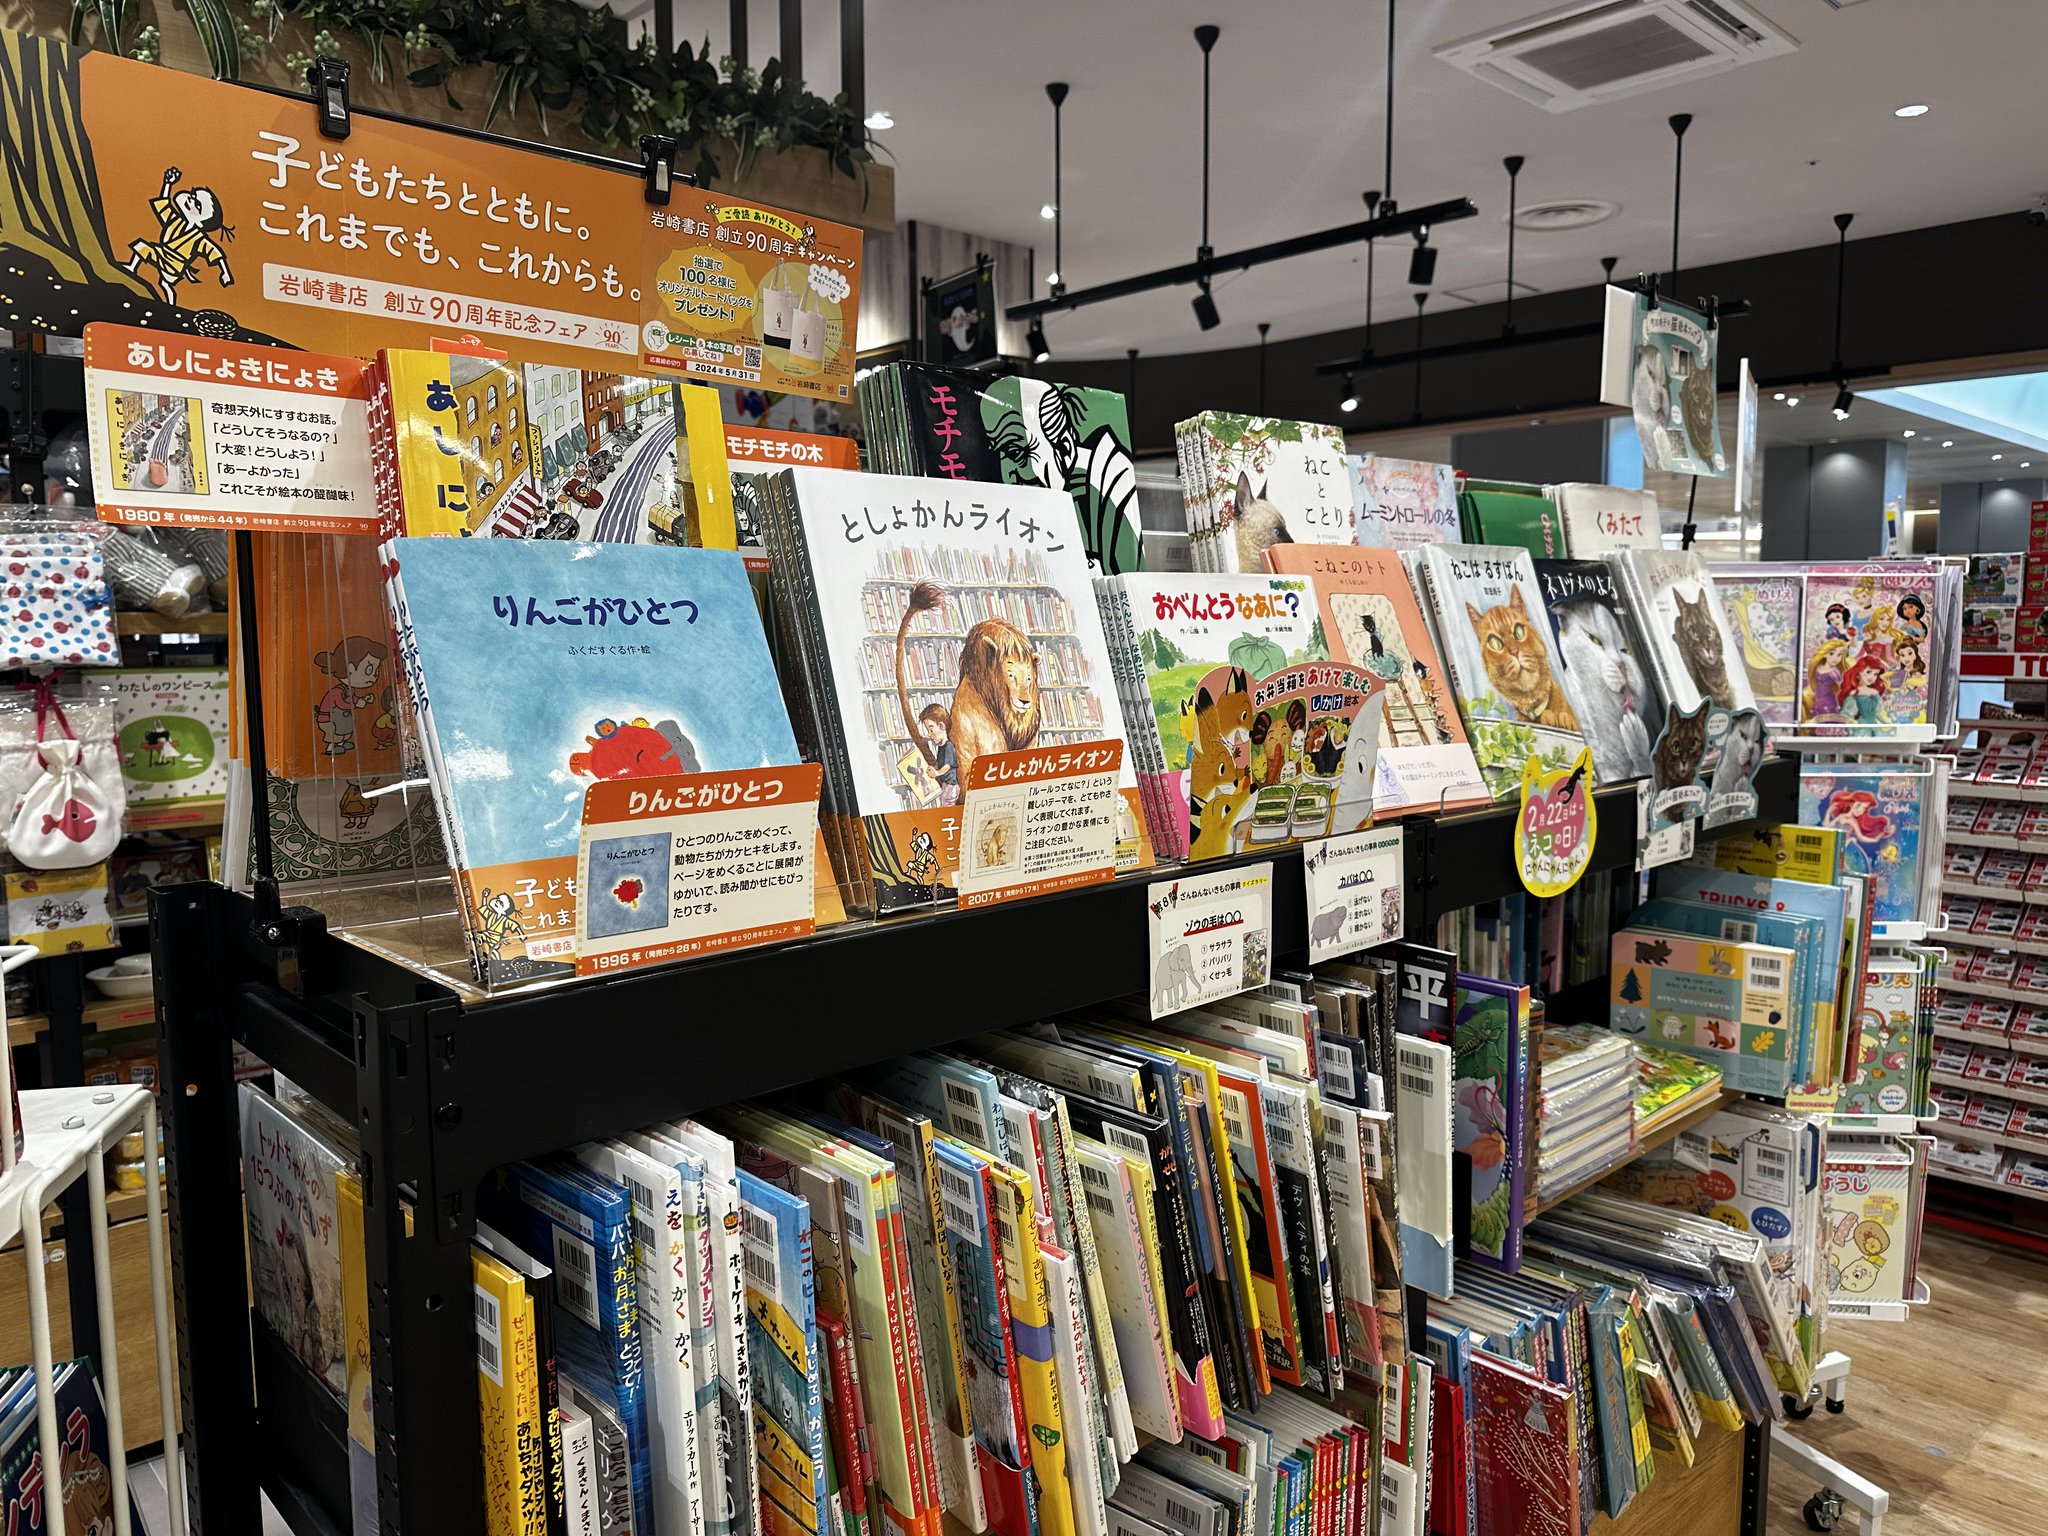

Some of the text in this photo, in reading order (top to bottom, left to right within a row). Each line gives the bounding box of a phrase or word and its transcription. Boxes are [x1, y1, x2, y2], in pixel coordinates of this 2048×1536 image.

[252, 131, 590, 241] 子どもたちとともに。
[651, 210, 710, 238] 岩崎書店
[259, 200, 641, 302] これまでも、これからも。
[693, 255, 724, 272] 抽選で
[679, 267, 736, 289] 100名様に
[279, 273, 588, 340] 岩崎書店 創立90周年記念フェア
[658, 281, 753, 309] オリジナルトートバッグを
[675, 299, 735, 321] プレゼント！
[603, 328, 621, 345] 90
[127, 341, 339, 392] あしにょきにょき
[696, 364, 754, 379] 2024年5月31日
[211, 402, 338, 427] 奇想天外にすすむお話。
[213, 422, 338, 445] 「どうしてそうなるの？」
[215, 442, 325, 462] 「大変！どうしよう！」
[727, 435, 824, 464] モチモチの木
[217, 462, 300, 480] 「あーよかった」
[1305, 455, 1330, 476] ねこ
[219, 483, 356, 502] これこそが絵本の醍醐味！
[1317, 483, 1326, 499] と
[115, 508, 175, 523] 1980年
[252, 517, 280, 526] 岩崎書店
[283, 517, 353, 530] 創立90周年記念フェア
[842, 499, 1065, 554] としょかんライオン
[1305, 506, 1343, 528] ことり
[1361, 502, 1456, 527] ムーミントロールの冬
[1596, 511, 1643, 537] くみたて
[785, 485, 813, 600] としょかんライオン
[1314, 559, 1385, 575] こねこのトト
[1450, 559, 1524, 582] ねこは るすばん
[1542, 573, 1618, 600] ネコヅメのよる
[1757, 589, 1793, 602] ぬりえ
[492, 594, 699, 627] りんごがひとつ
[568, 643, 652, 657] ふくだすぐる作・絵
[117, 679, 214, 693] わたしのワンピース
[1254, 667, 1372, 707] お弁当箱をあけて楽しむ
[1311, 694, 1360, 713] しかけ絵本
[983, 749, 1114, 782] としょかんライオン
[628, 780, 784, 816] りんごがひとつ
[1028, 777, 1113, 797] 「ルールってなに？」という
[1027, 791, 1111, 811] 難しいテーマを、とてもやさ
[1025, 816, 1110, 837] ライオンの豊かな表情にも
[1027, 806, 1094, 824] しく表現してくれます。
[675, 826, 794, 849] ひとつのりんごをめぐって、
[1024, 836, 1074, 851] ご注目ください。
[1530, 825, 1577, 857] ネコの日！
[674, 842, 804, 867] 動物たちがカケヒキをします。
[1525, 848, 1586, 877] にゃんにゃんにゃん！
[673, 856, 805, 882] ページをめくるごとに展開が
[673, 873, 804, 901] ゆかいで、読み聞かせにもぴっ
[1180, 882, 1242, 901] ざんねんないきもの事典
[522, 908, 577, 931] これま
[673, 901, 719, 920] たりです。
[530, 940, 573, 957] 岩崎書店
[592, 951, 642, 970] 1996年
[706, 938, 728, 947] 岩崎書店
[1402, 963, 1448, 1020] 平
[1172, 1072, 1188, 1123] すてきな
[259, 1121, 320, 1201] トットちゃんの
[665, 1187, 683, 1231] えを
[925, 1140, 954, 1296] ツリーハウスがほしいなら
[728, 1252, 745, 1327] ホットケーキ
[511, 1312, 526, 1363] ぜったい
[514, 1370, 530, 1419] ぜったい
[576, 1455, 589, 1499] くまさん
